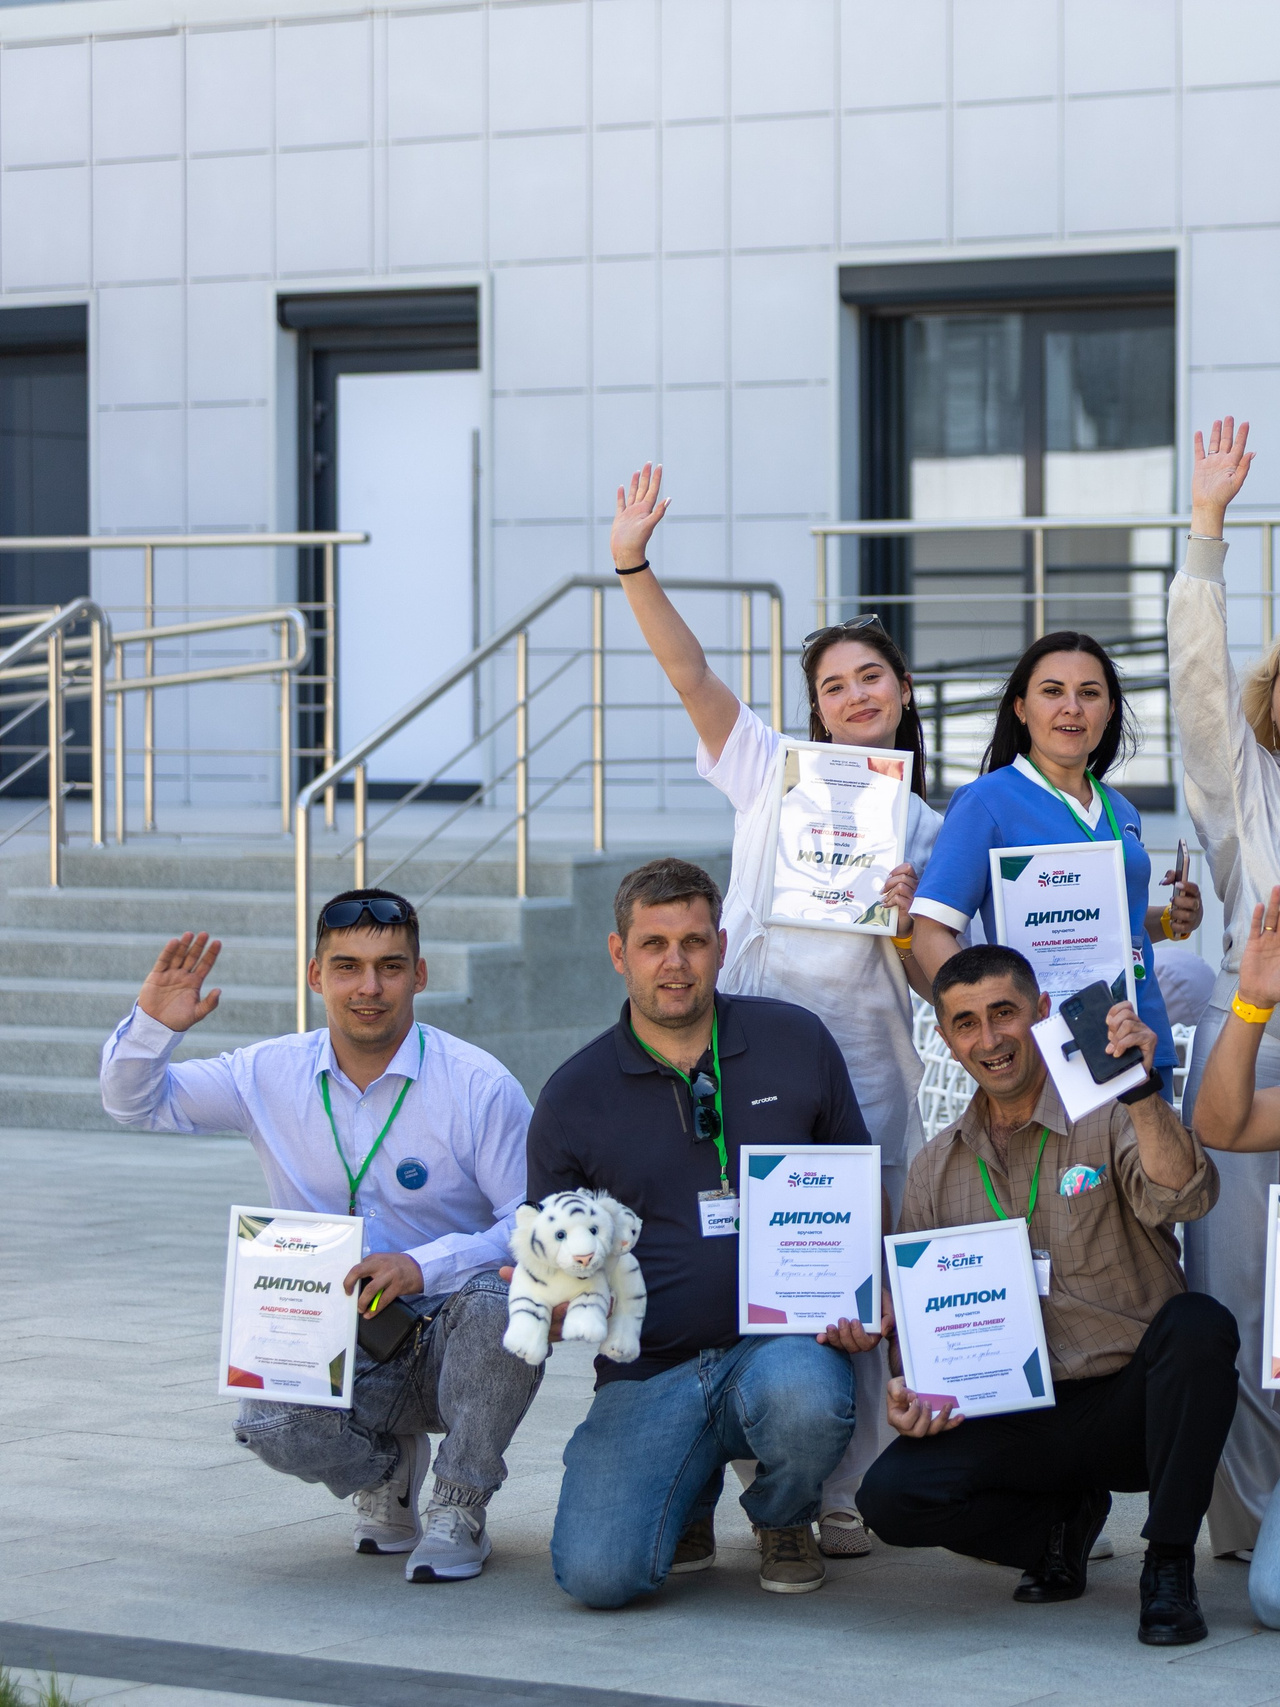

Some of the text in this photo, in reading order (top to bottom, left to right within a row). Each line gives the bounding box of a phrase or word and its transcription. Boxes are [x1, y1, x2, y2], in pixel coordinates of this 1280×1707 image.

[796, 849, 876, 868] ДИПЛОМ
[1051, 872, 1081, 884] СЛЁТ
[810, 890, 840, 900] СЛЁТ
[1024, 908, 1100, 927] ДИПЛОМ
[1032, 936, 1098, 947] НАТАЛЬЕ ИВАНОВОЙ
[751, 1095, 778, 1106] strobbs
[802, 1174, 834, 1185] СЛЁТ
[708, 1216, 734, 1225] СЕРГЕЙ
[768, 1212, 852, 1226] ДИПЛОМ
[288, 1242, 319, 1254] СЛЁТ
[952, 1254, 984, 1268] СЛЁТ
[254, 1275, 332, 1294] ДИПЛОМ
[925, 1288, 1006, 1313] ДИПЛОМ
[260, 1305, 323, 1316] АНДРЕЮ ЯКУШОВУ
[934, 1322, 972, 1333] ДИЛЯВЕРУ
[972, 1318, 1006, 1328] ВАЛИЕВУ
